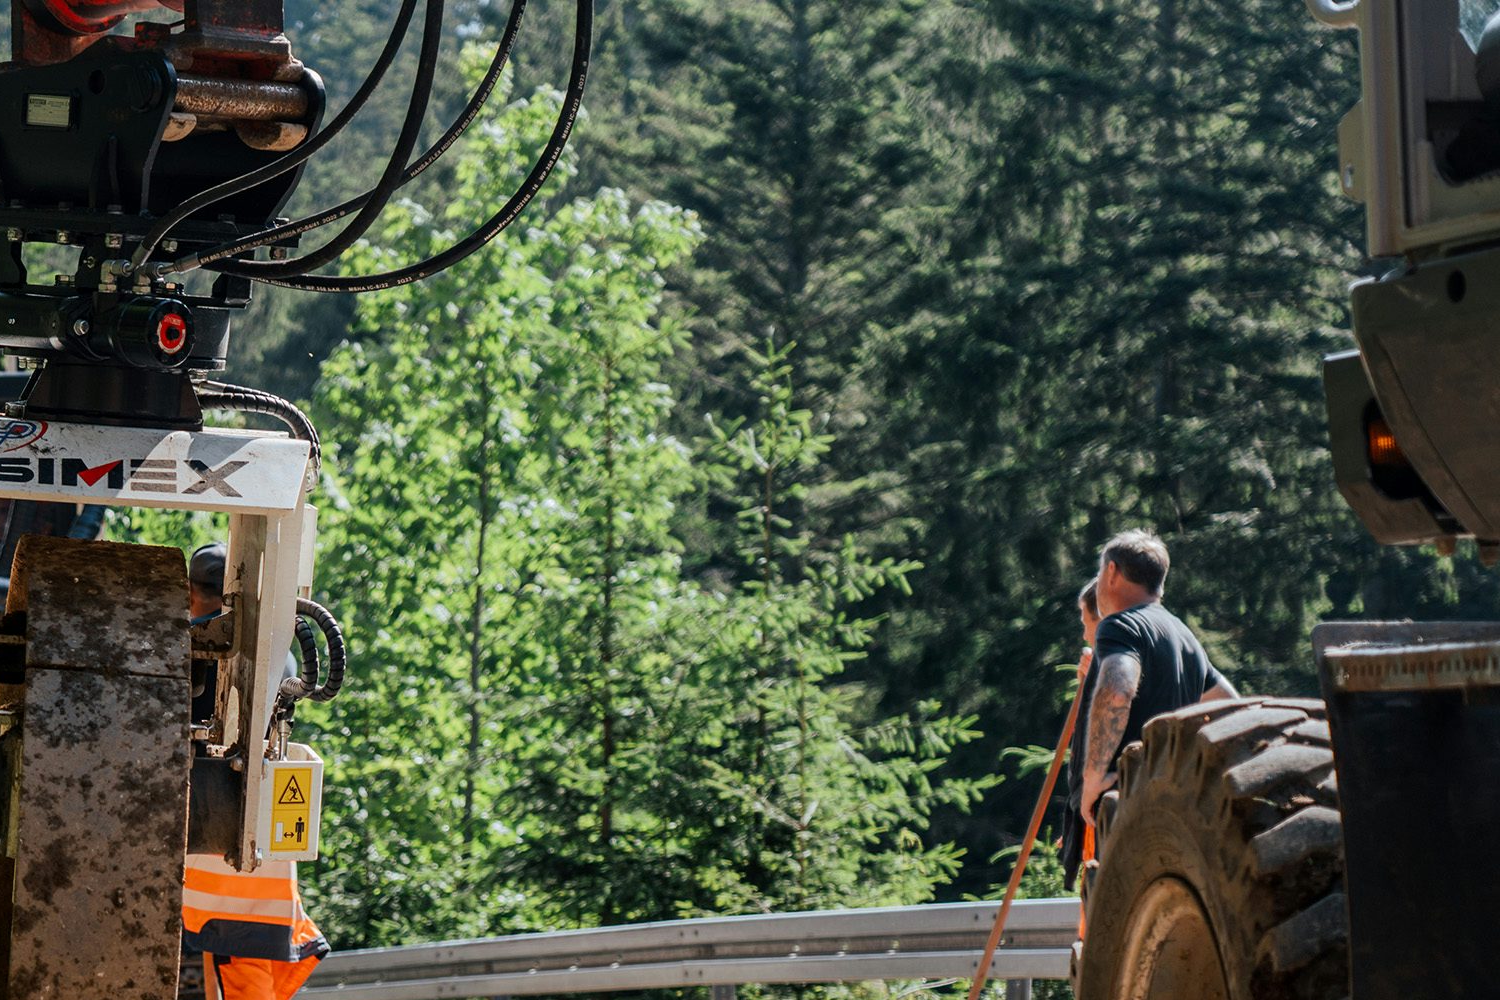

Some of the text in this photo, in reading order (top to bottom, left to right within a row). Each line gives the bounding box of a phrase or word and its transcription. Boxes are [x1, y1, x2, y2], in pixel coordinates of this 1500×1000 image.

[539, 171, 547, 181] WP
[551, 146, 561, 160] BAR
[562, 121, 572, 139] MSHA
